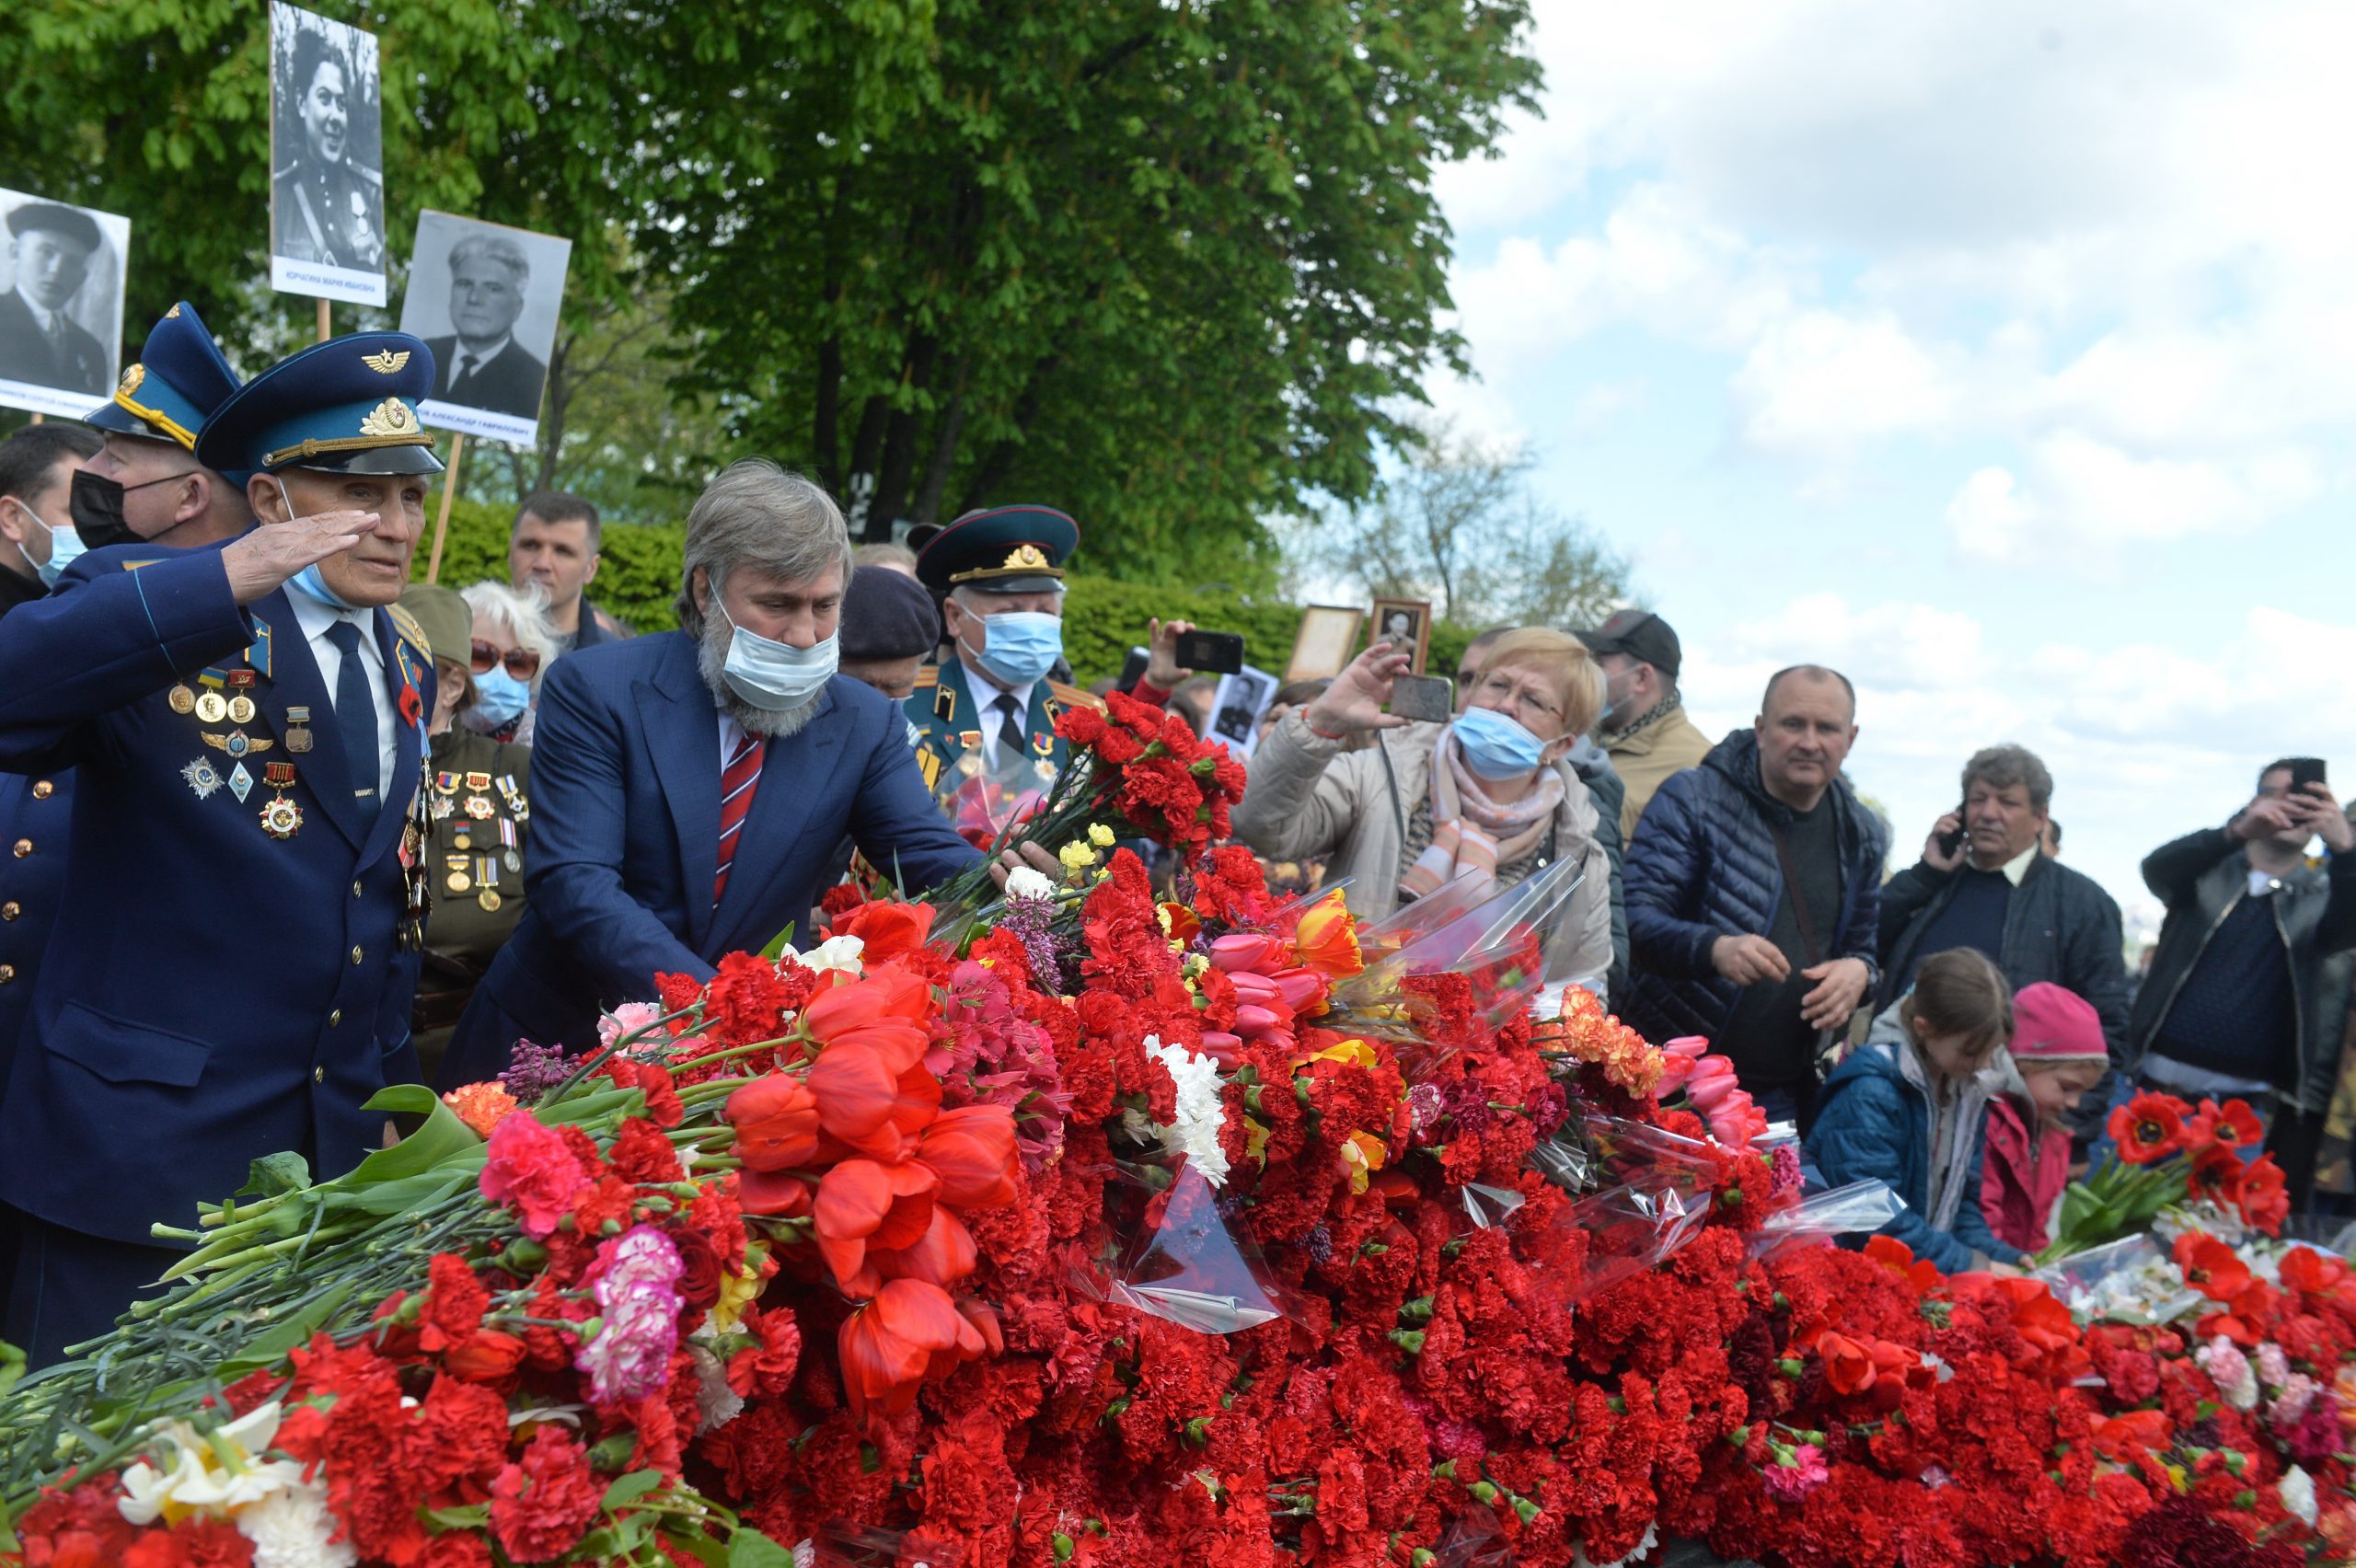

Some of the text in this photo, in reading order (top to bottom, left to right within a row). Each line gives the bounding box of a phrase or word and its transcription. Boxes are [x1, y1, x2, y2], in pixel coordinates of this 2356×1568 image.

[285, 271, 375, 293] КОРЧАГИНА МАРИЯ ИВАНОВНА
[431, 411, 477, 426] АЛЕКСАНДР
[478, 421, 529, 435] ГАВРИЛОВИЧ
